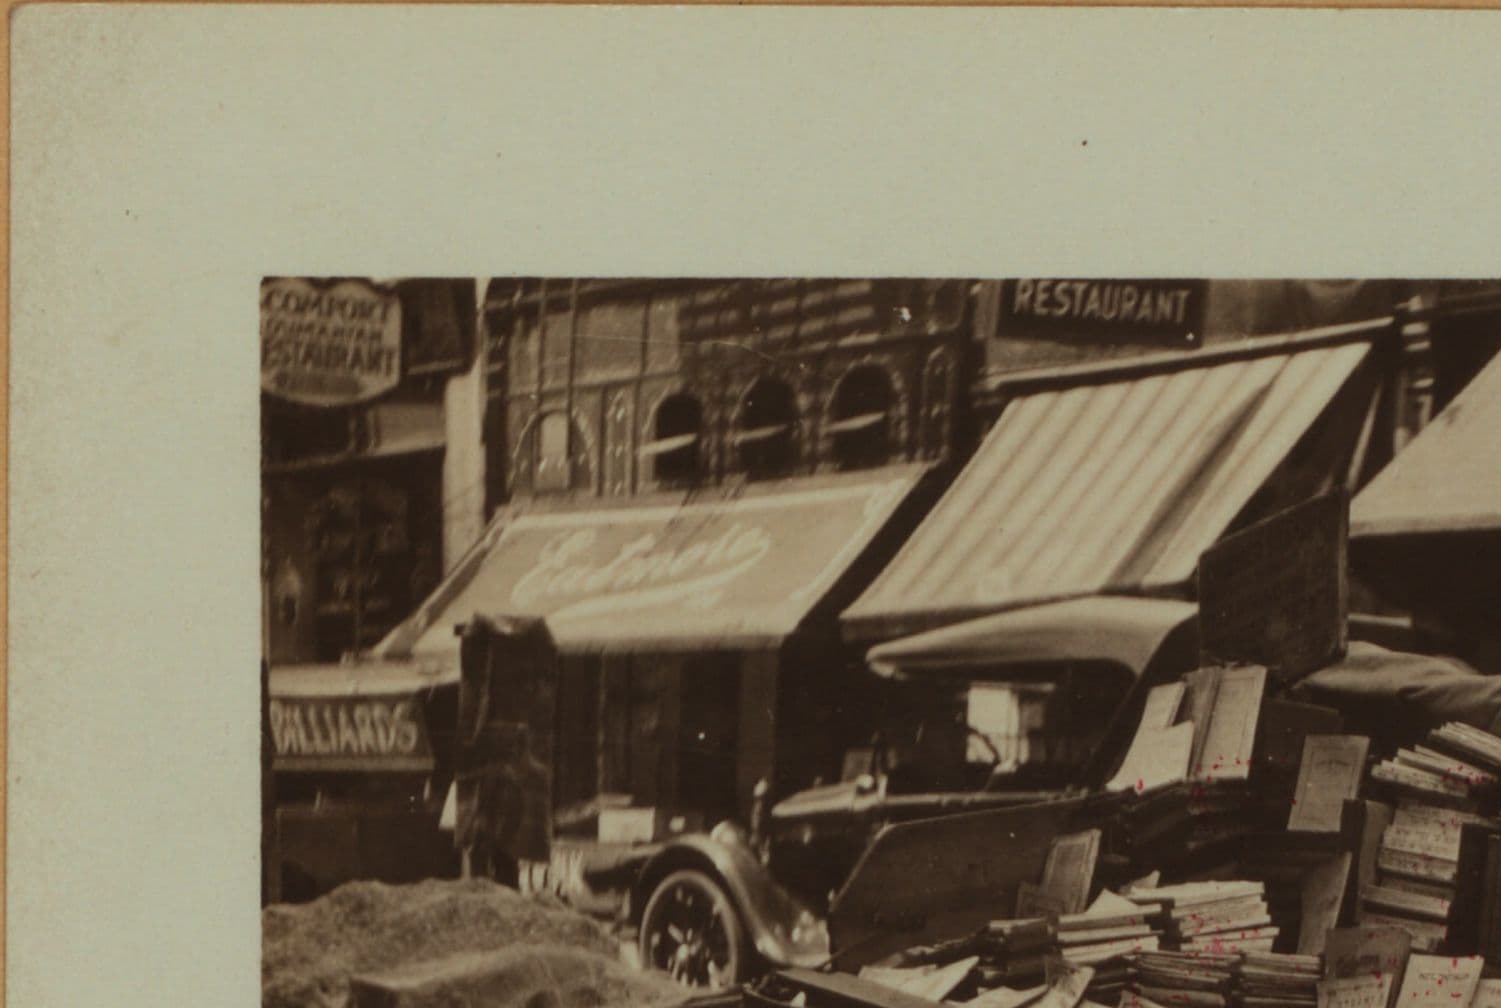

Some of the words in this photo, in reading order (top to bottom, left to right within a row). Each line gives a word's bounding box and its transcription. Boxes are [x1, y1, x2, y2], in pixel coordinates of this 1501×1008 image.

[1013, 279, 1190, 324] RESTAURANT
[261, 338, 397, 378] ESTAURANT
[270, 699, 417, 755] BILLIARDS
